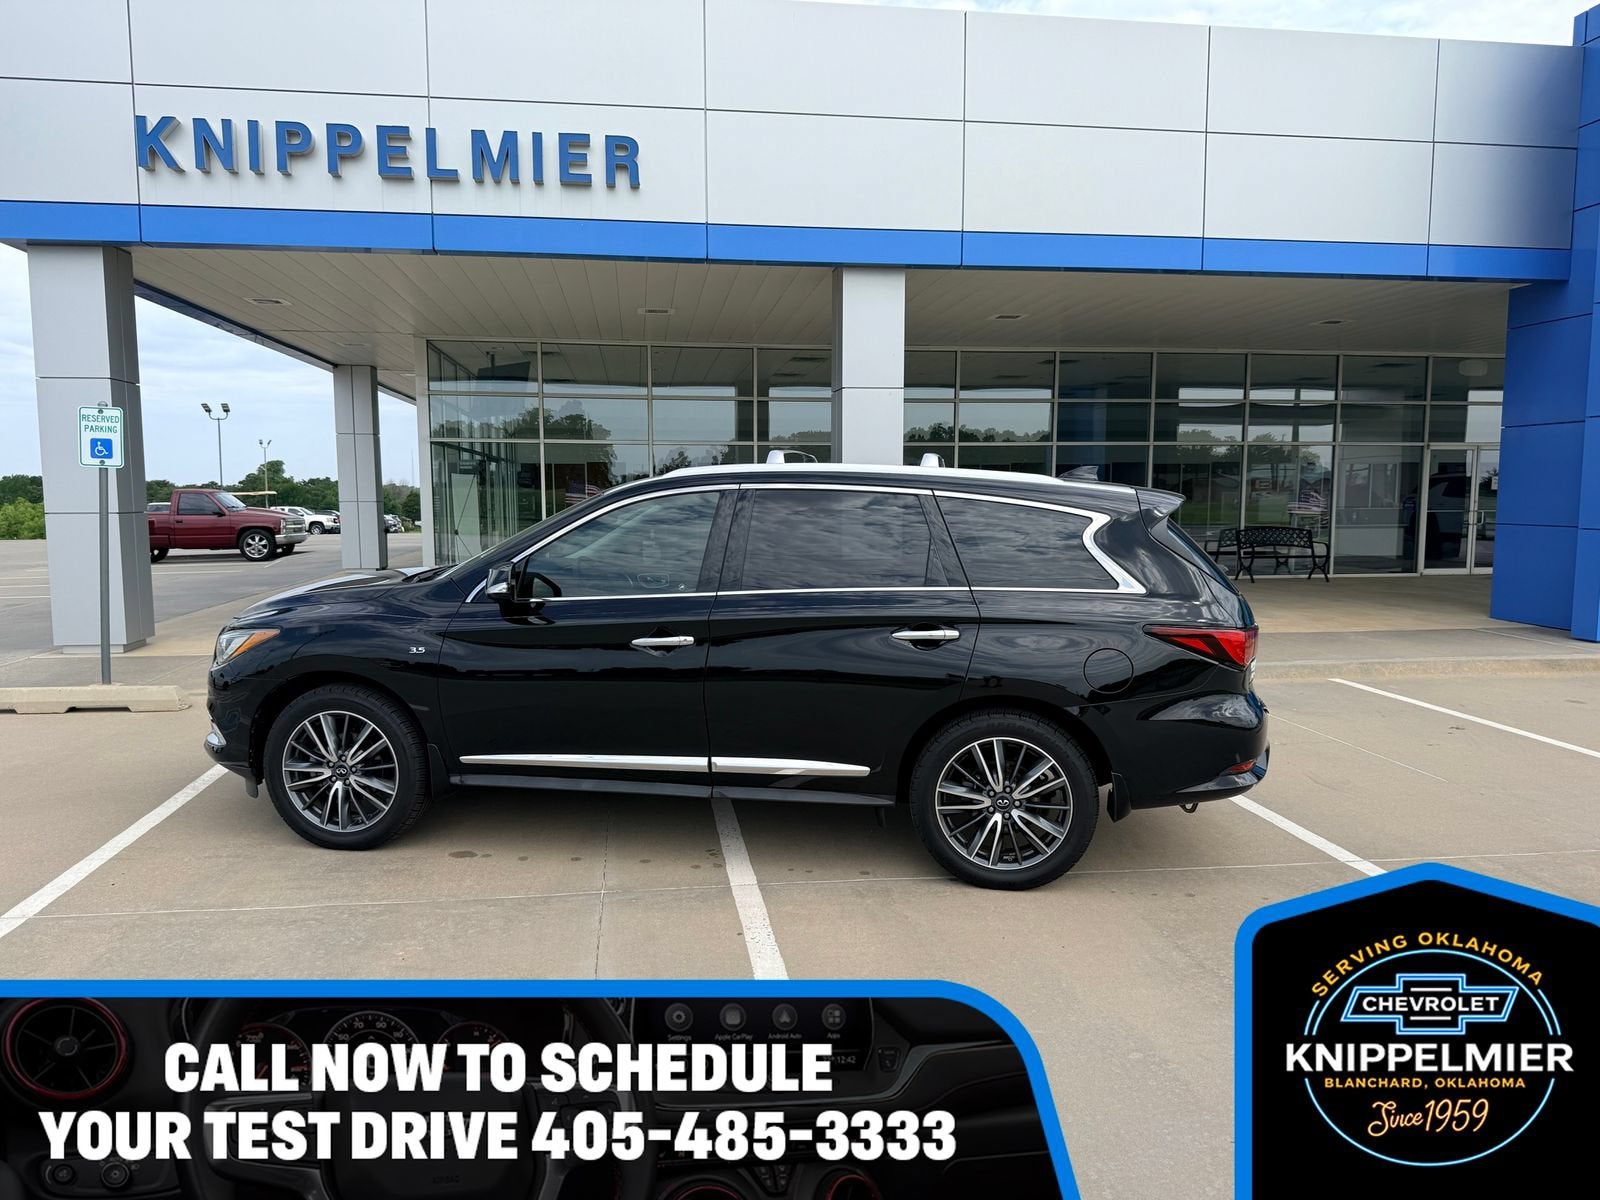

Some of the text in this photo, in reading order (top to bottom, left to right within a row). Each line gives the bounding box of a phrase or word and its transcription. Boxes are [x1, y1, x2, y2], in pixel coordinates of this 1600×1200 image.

[135, 114, 641, 189] KNIPPELMIER
[81, 414, 120, 424] RESERVED
[84, 424, 118, 434] PARKING
[409, 646, 426, 654] 3.5
